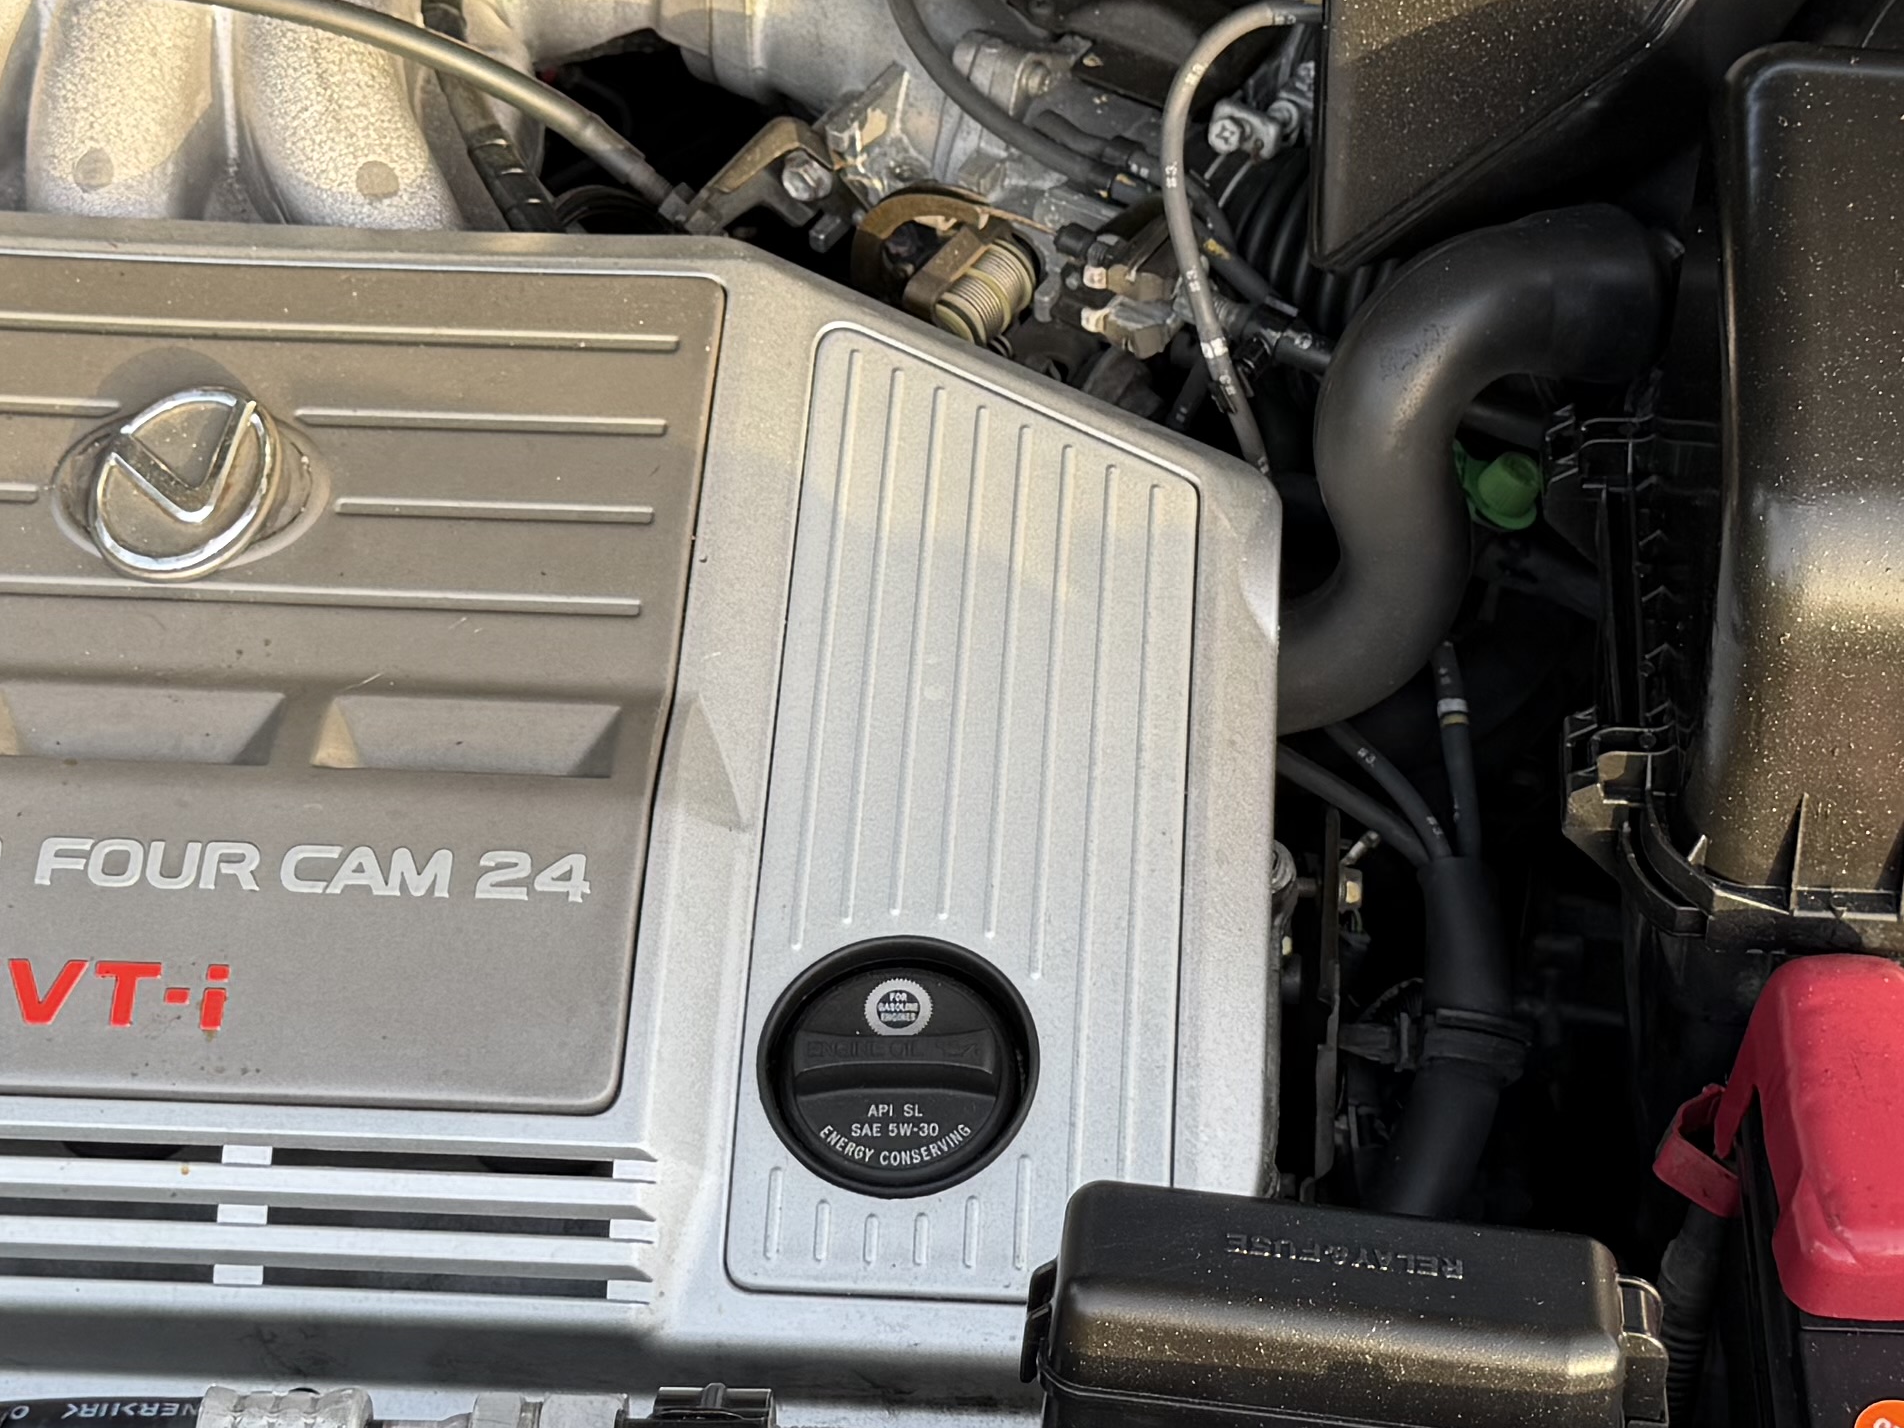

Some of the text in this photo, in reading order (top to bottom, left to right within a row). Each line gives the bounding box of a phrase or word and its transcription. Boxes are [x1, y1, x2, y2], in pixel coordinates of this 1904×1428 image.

[35, 837, 260, 893] FOUR
[280, 844, 453, 901] CAM
[474, 849, 591, 904] 24
[889, 992, 908, 1001] FOR
[807, 1040, 924, 1058] ENGINE OIL
[867, 1104, 923, 1117] API SL
[851, 1123, 939, 1137] SAE 5W-30
[819, 1124, 972, 1165] ENERGY CONSERVING
